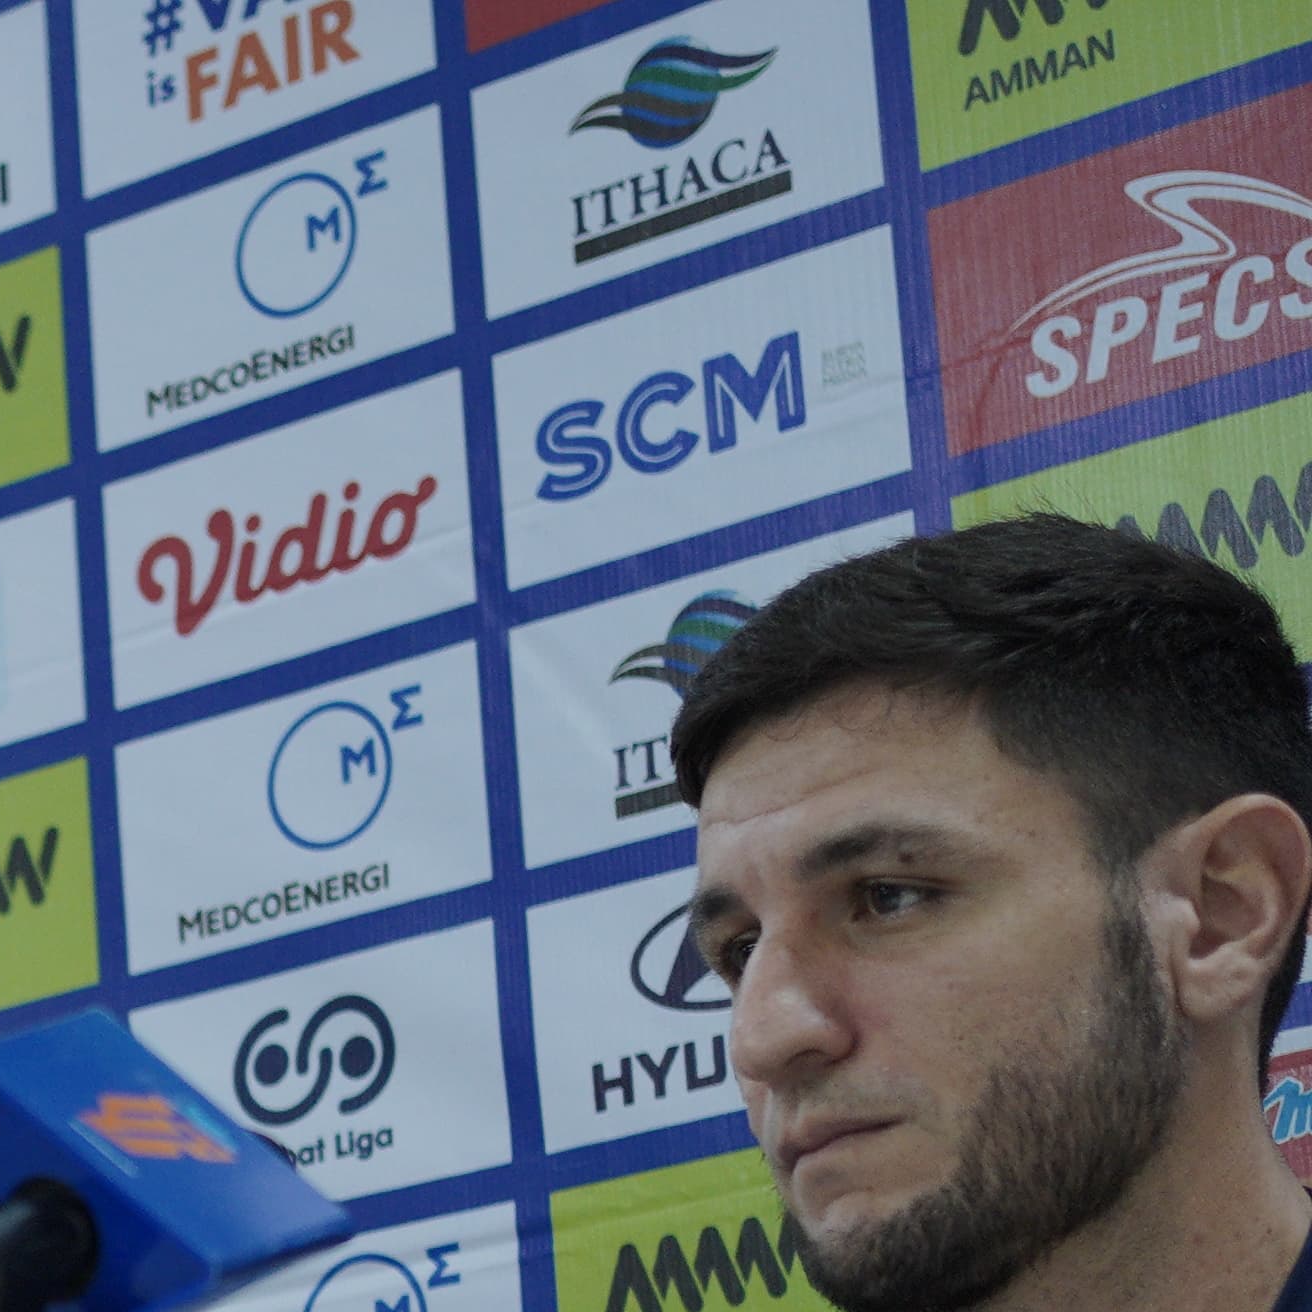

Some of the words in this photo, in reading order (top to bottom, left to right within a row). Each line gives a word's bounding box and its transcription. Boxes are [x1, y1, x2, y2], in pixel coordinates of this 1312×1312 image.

[146, 69, 176, 108] is
[184, 0, 361, 124] FAIR
[964, 30, 1117, 111] AMMAN
[572, 127, 790, 238] ITHACA
[534, 330, 807, 502] SCM
[134, 473, 438, 638] Vidio
[334, 1126, 394, 1160] Liga
